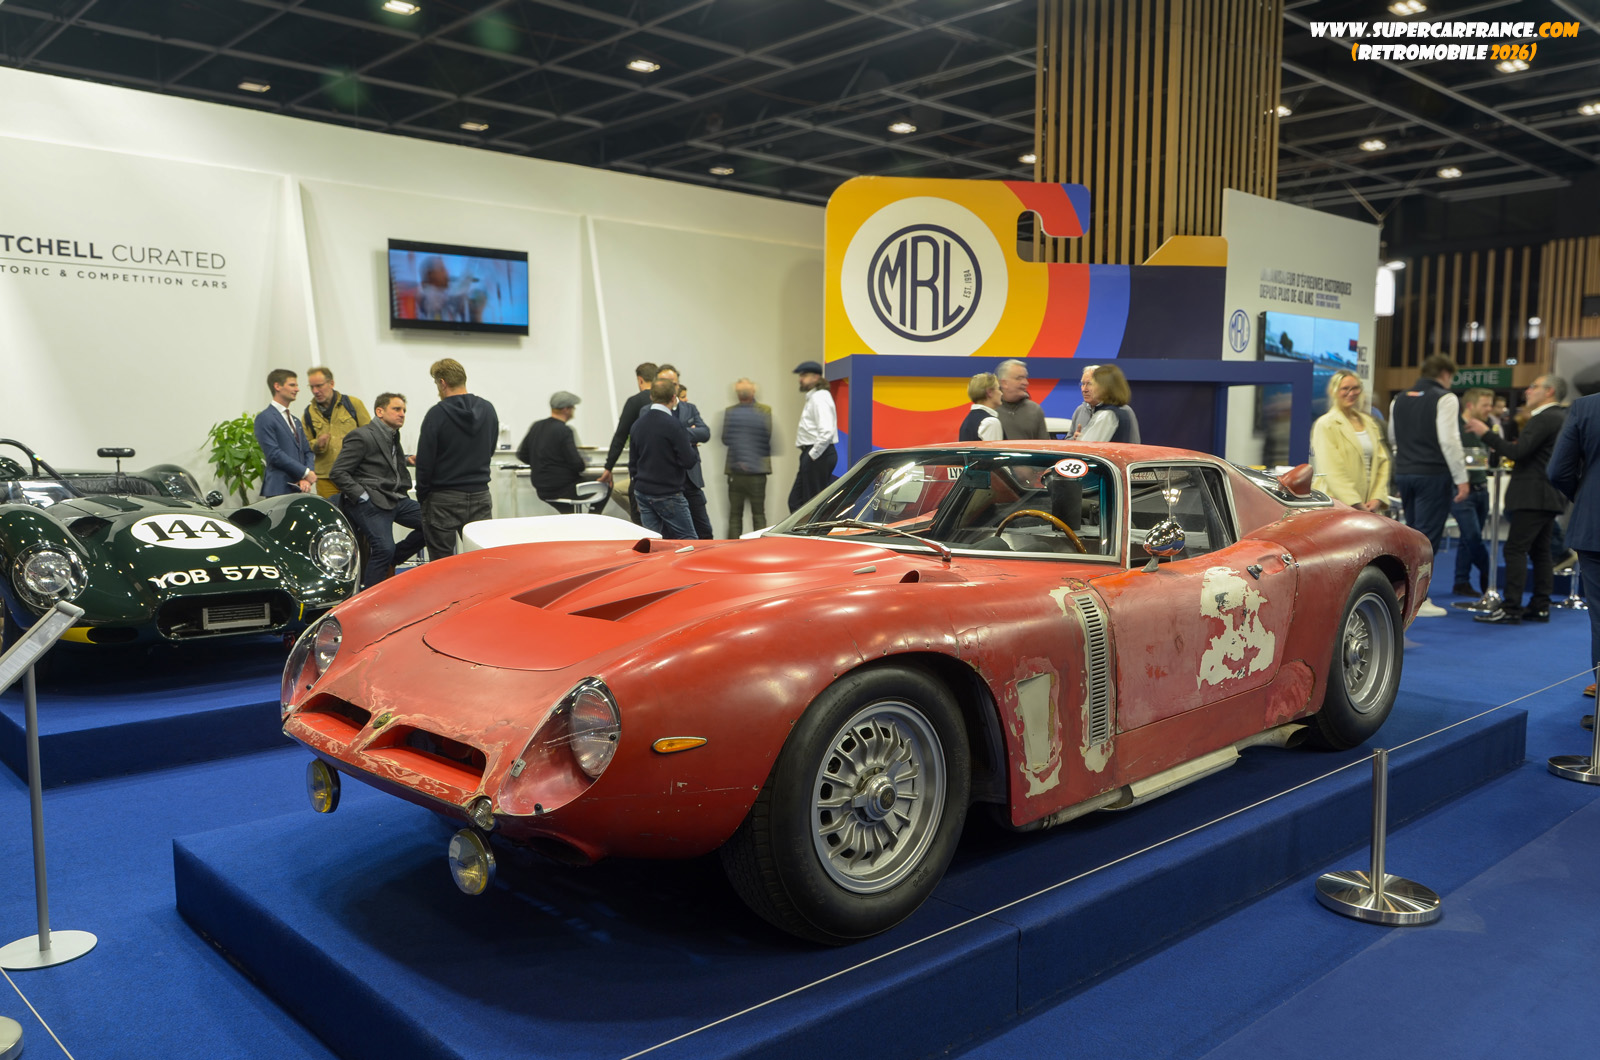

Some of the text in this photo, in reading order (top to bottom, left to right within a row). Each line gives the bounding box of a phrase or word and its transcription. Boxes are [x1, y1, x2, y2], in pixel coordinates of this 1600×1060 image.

[111, 244, 226, 270] CURATED
[59, 269, 67, 278] &
[77, 270, 183, 286] COMPETITION
[191, 279, 228, 290] CARS
[878, 235, 965, 331] MRL
[1452, 370, 1499, 385] ORTIE
[1061, 463, 1082, 474] 38
[141, 520, 234, 542] 144
[148, 565, 280, 589] YOB 575
